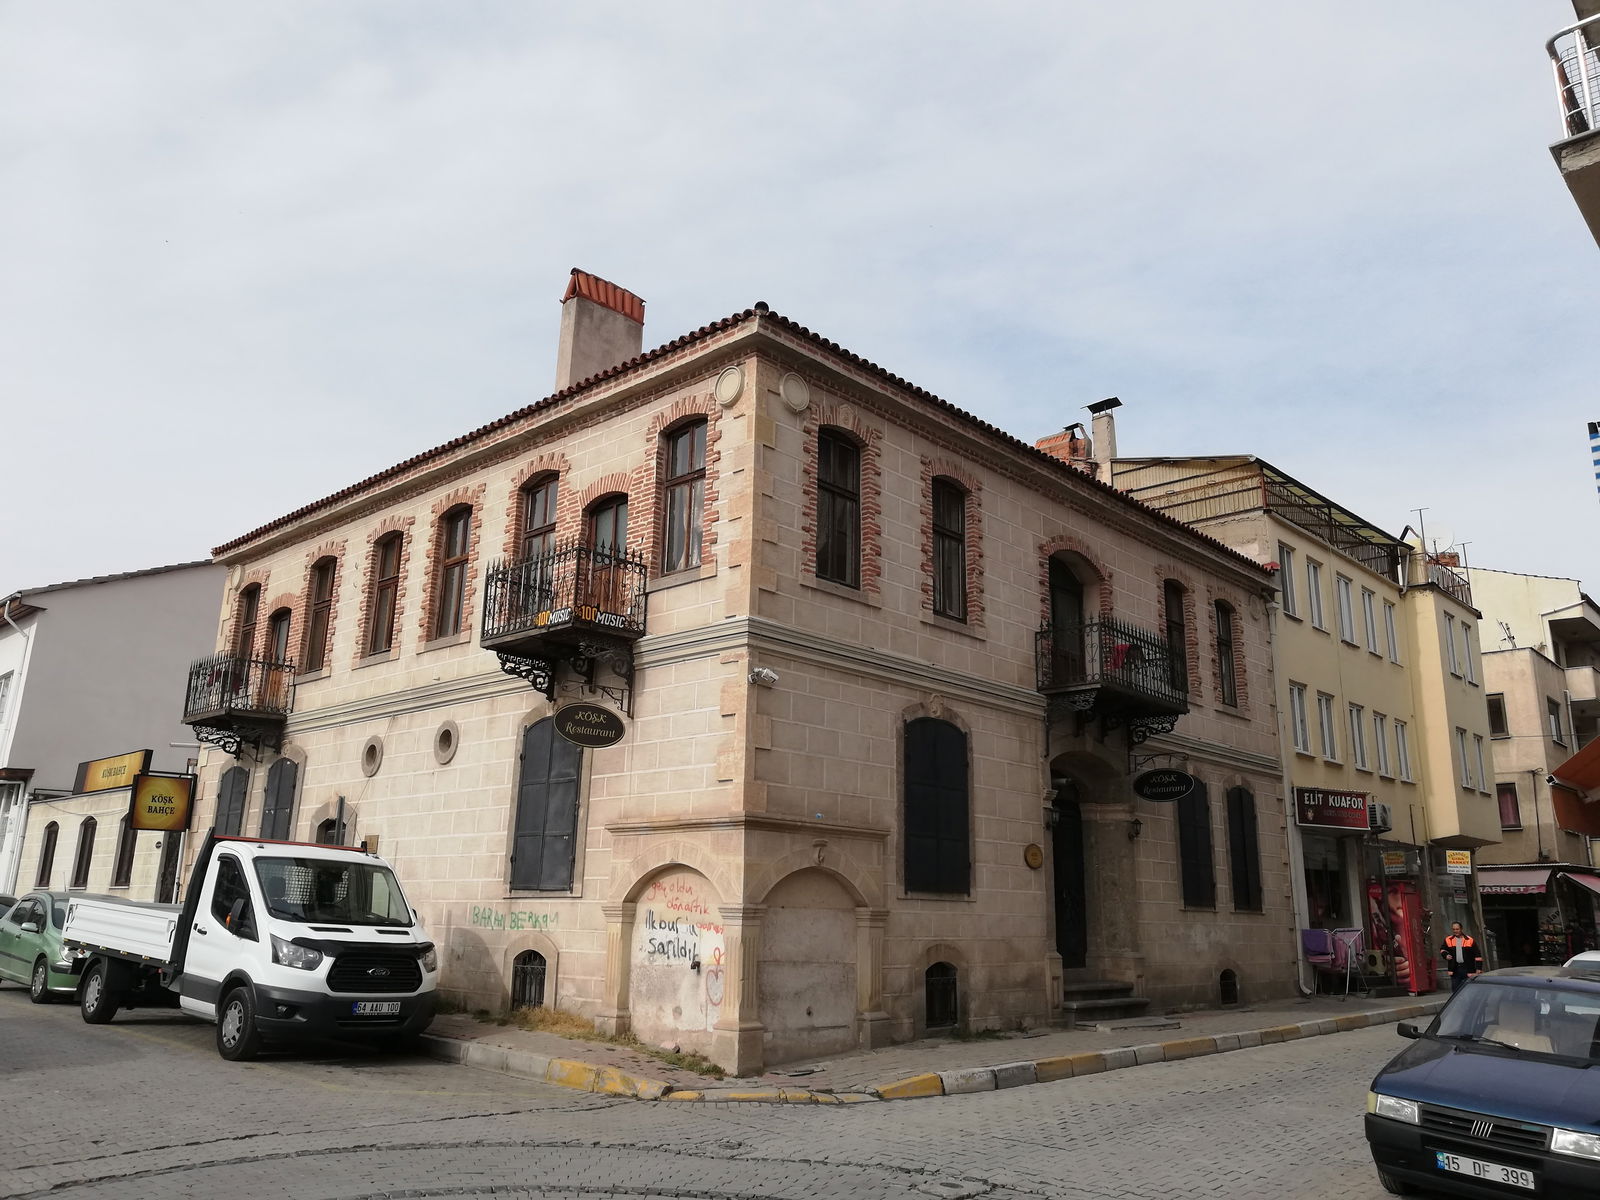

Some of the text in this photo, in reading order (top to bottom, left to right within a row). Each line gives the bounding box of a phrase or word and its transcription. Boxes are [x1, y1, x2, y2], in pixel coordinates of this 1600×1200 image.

[565, 721, 616, 738] Restaurant
[151, 794, 174, 805] KÖŞK
[147, 805, 175, 816] BAHÇE
[1445, 1155, 1529, 1187] 15 DF 399
